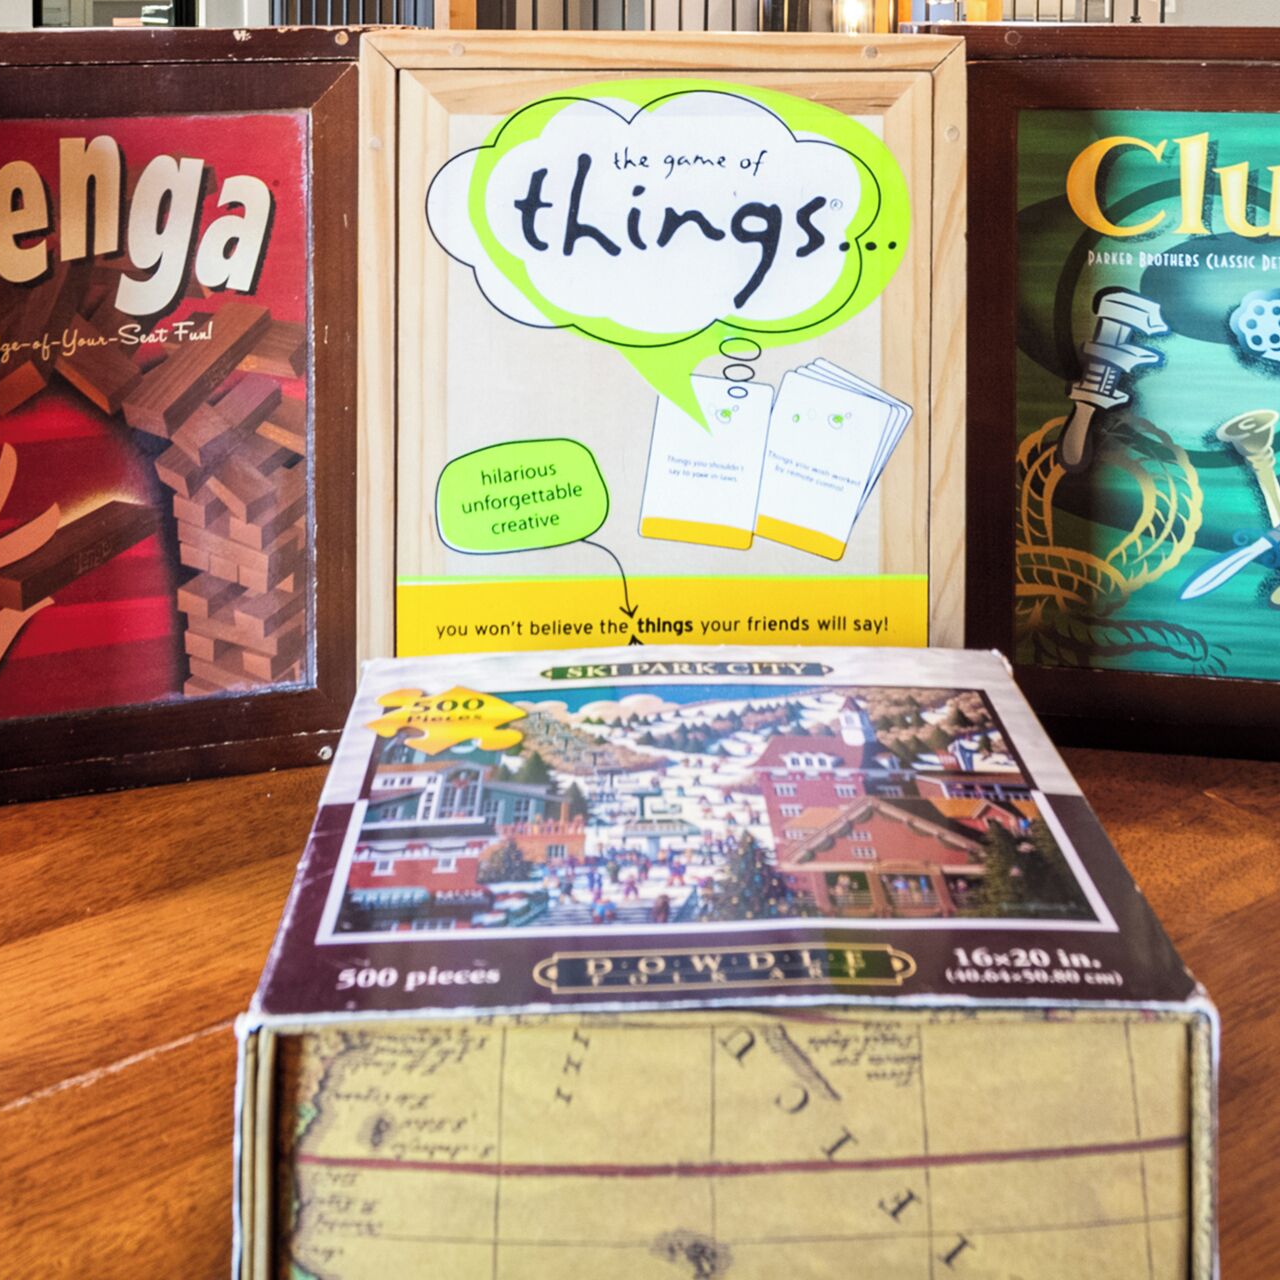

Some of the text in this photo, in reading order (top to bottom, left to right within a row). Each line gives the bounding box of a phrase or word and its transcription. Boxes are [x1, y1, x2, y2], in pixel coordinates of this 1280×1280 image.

[614, 146, 768, 179] the game of
[1088, 250, 1133, 266] PARKER
[1139, 251, 1199, 268] BROTHERS
[1206, 253, 1256, 270] CLASSIC
[173, 321, 213, 342] Fun!
[481, 463, 557, 486] hilarious
[462, 483, 583, 515] unforgettable
[491, 513, 560, 535] creative
[436, 616, 889, 639] you won't believe the things your friends will say!
[566, 661, 807, 679] SKI PARK CITY
[412, 697, 485, 713] 500
[335, 966, 501, 992] 500 pieces
